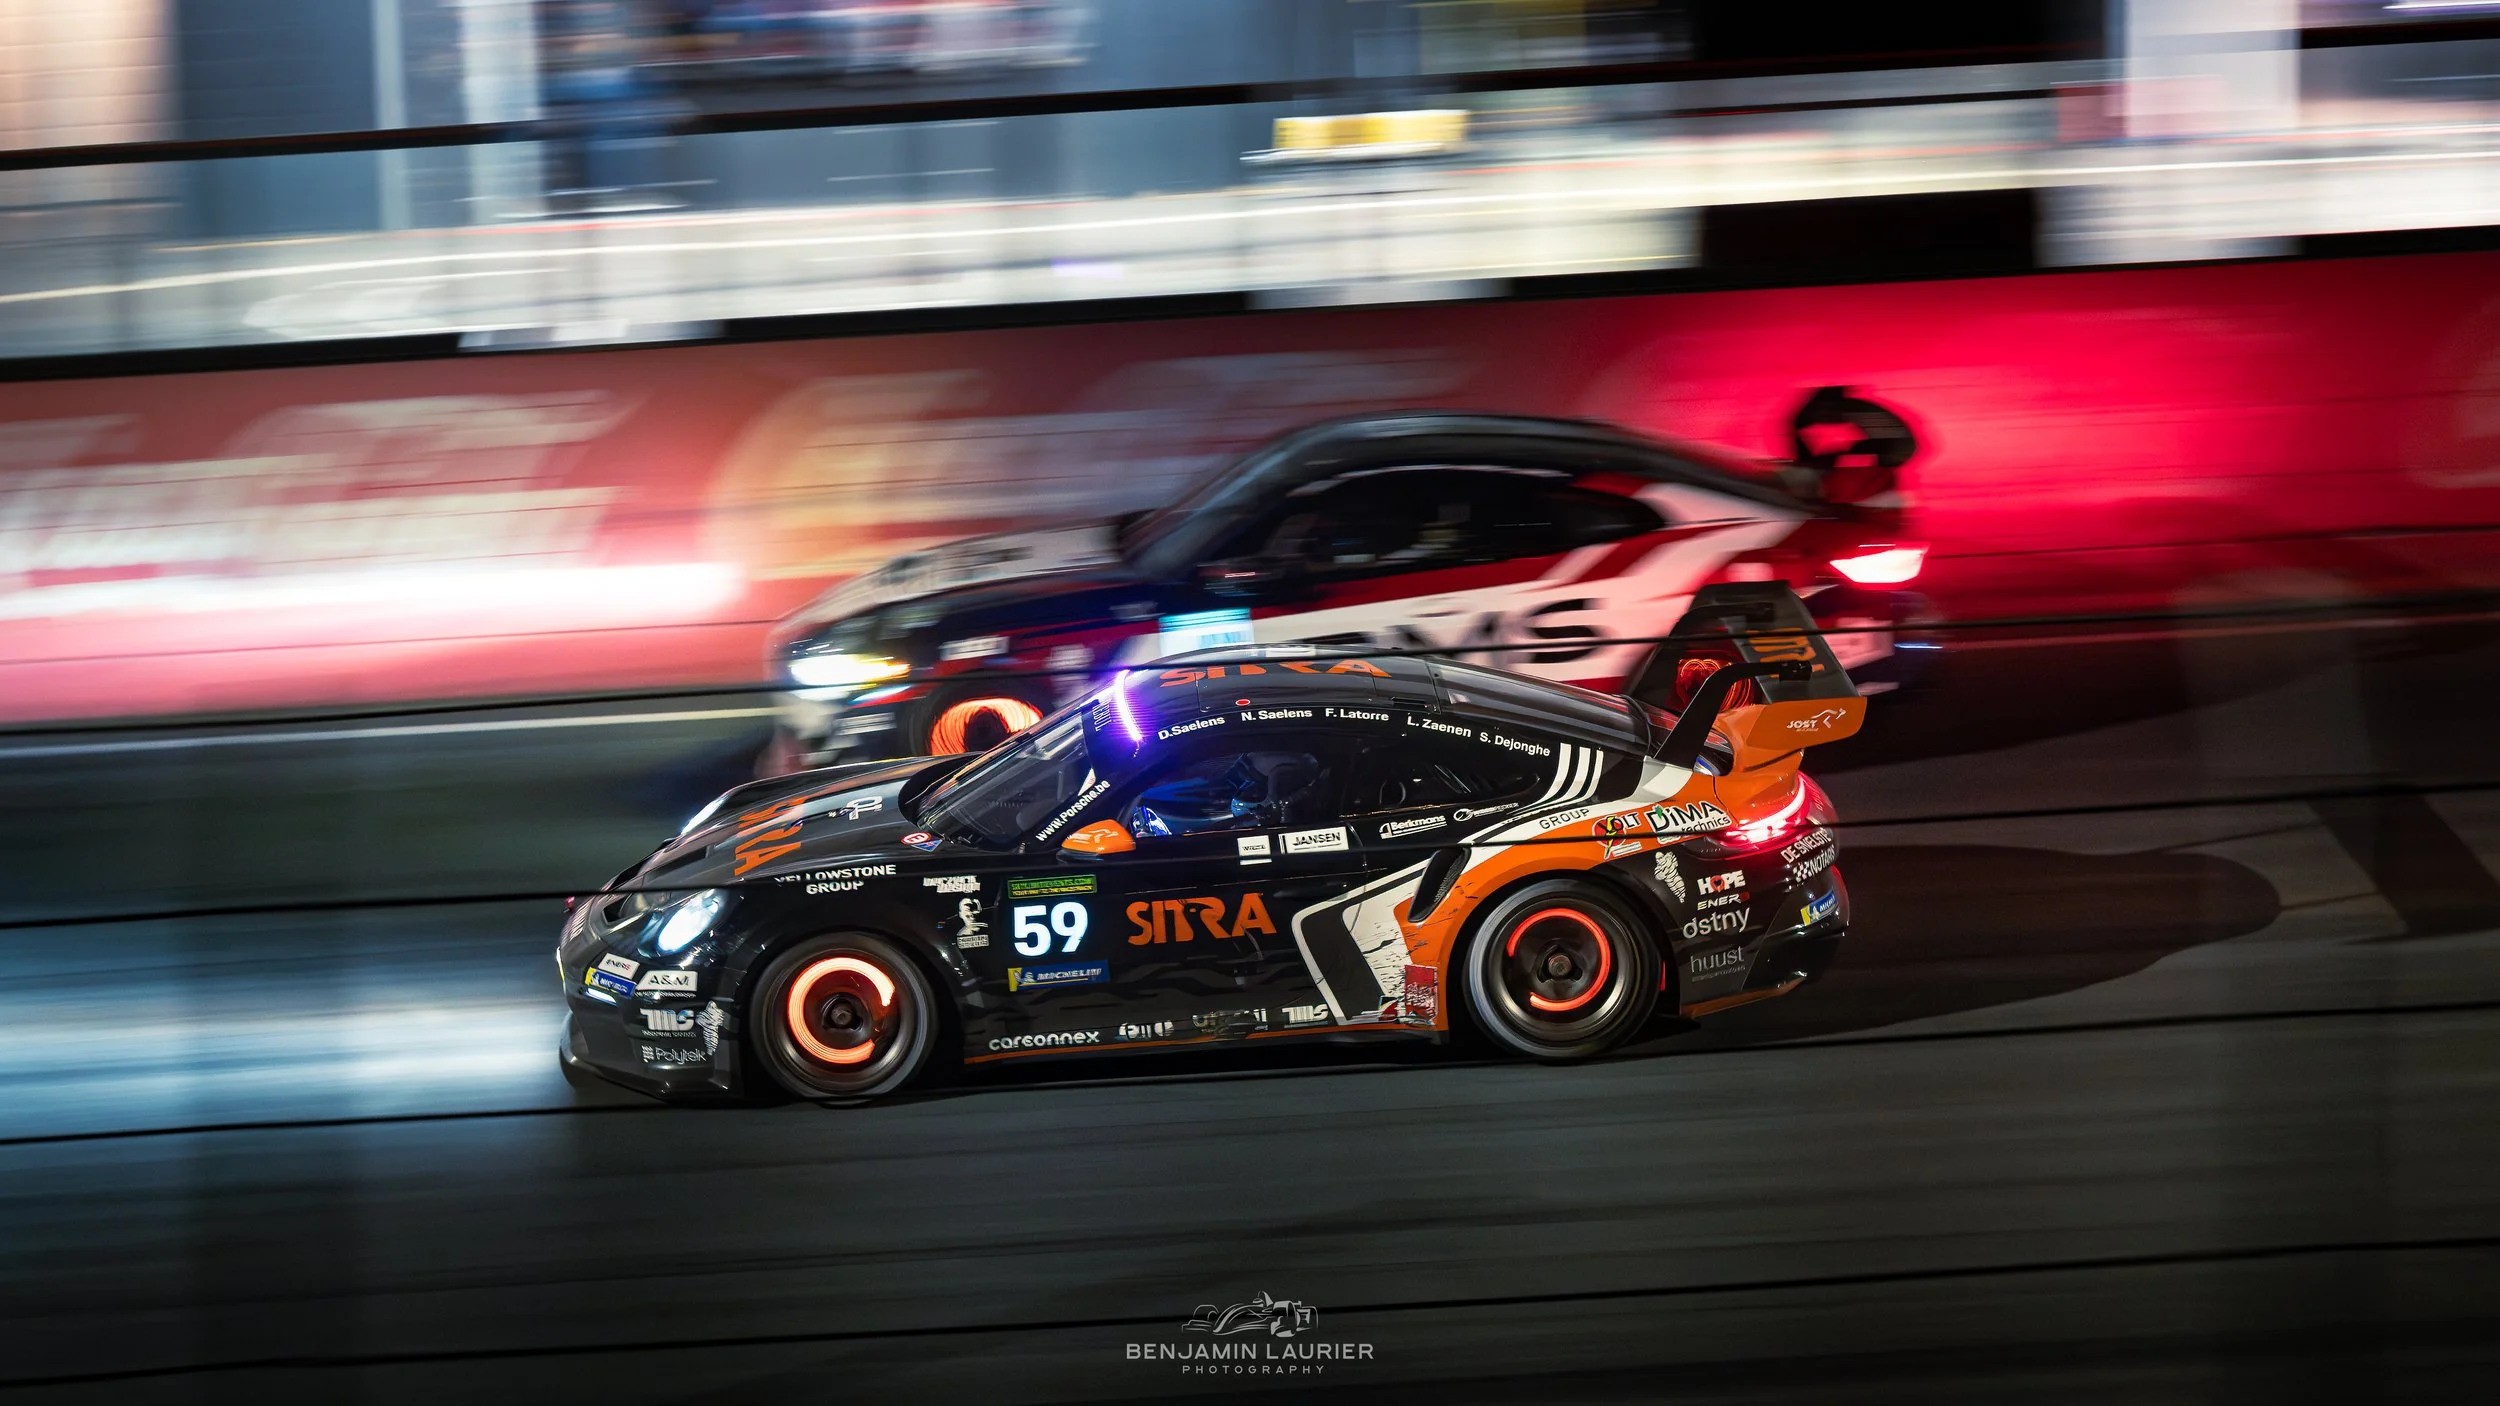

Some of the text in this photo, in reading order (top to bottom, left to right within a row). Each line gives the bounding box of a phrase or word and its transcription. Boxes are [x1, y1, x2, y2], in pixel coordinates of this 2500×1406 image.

[1241, 708, 1313, 721] N. Saelens
[1325, 708, 1390, 721] F. Latorre
[1787, 720, 1818, 729] JOST
[1158, 716, 1226, 740] D.Saelens
[1407, 716, 1472, 738] L. Zaenen
[1480, 732, 1551, 757] S. Dejonghe
[1539, 808, 1590, 829] GROUP
[1292, 832, 1341, 846] JANSEN
[806, 881, 865, 895] GROUP
[1697, 870, 1746, 895] HOPE
[1013, 901, 1089, 957] 59
[1126, 893, 1278, 945] SITRA
[1683, 907, 1750, 939] dstny
[1690, 945, 1745, 973] huust
[648, 975, 689, 987] A&M
